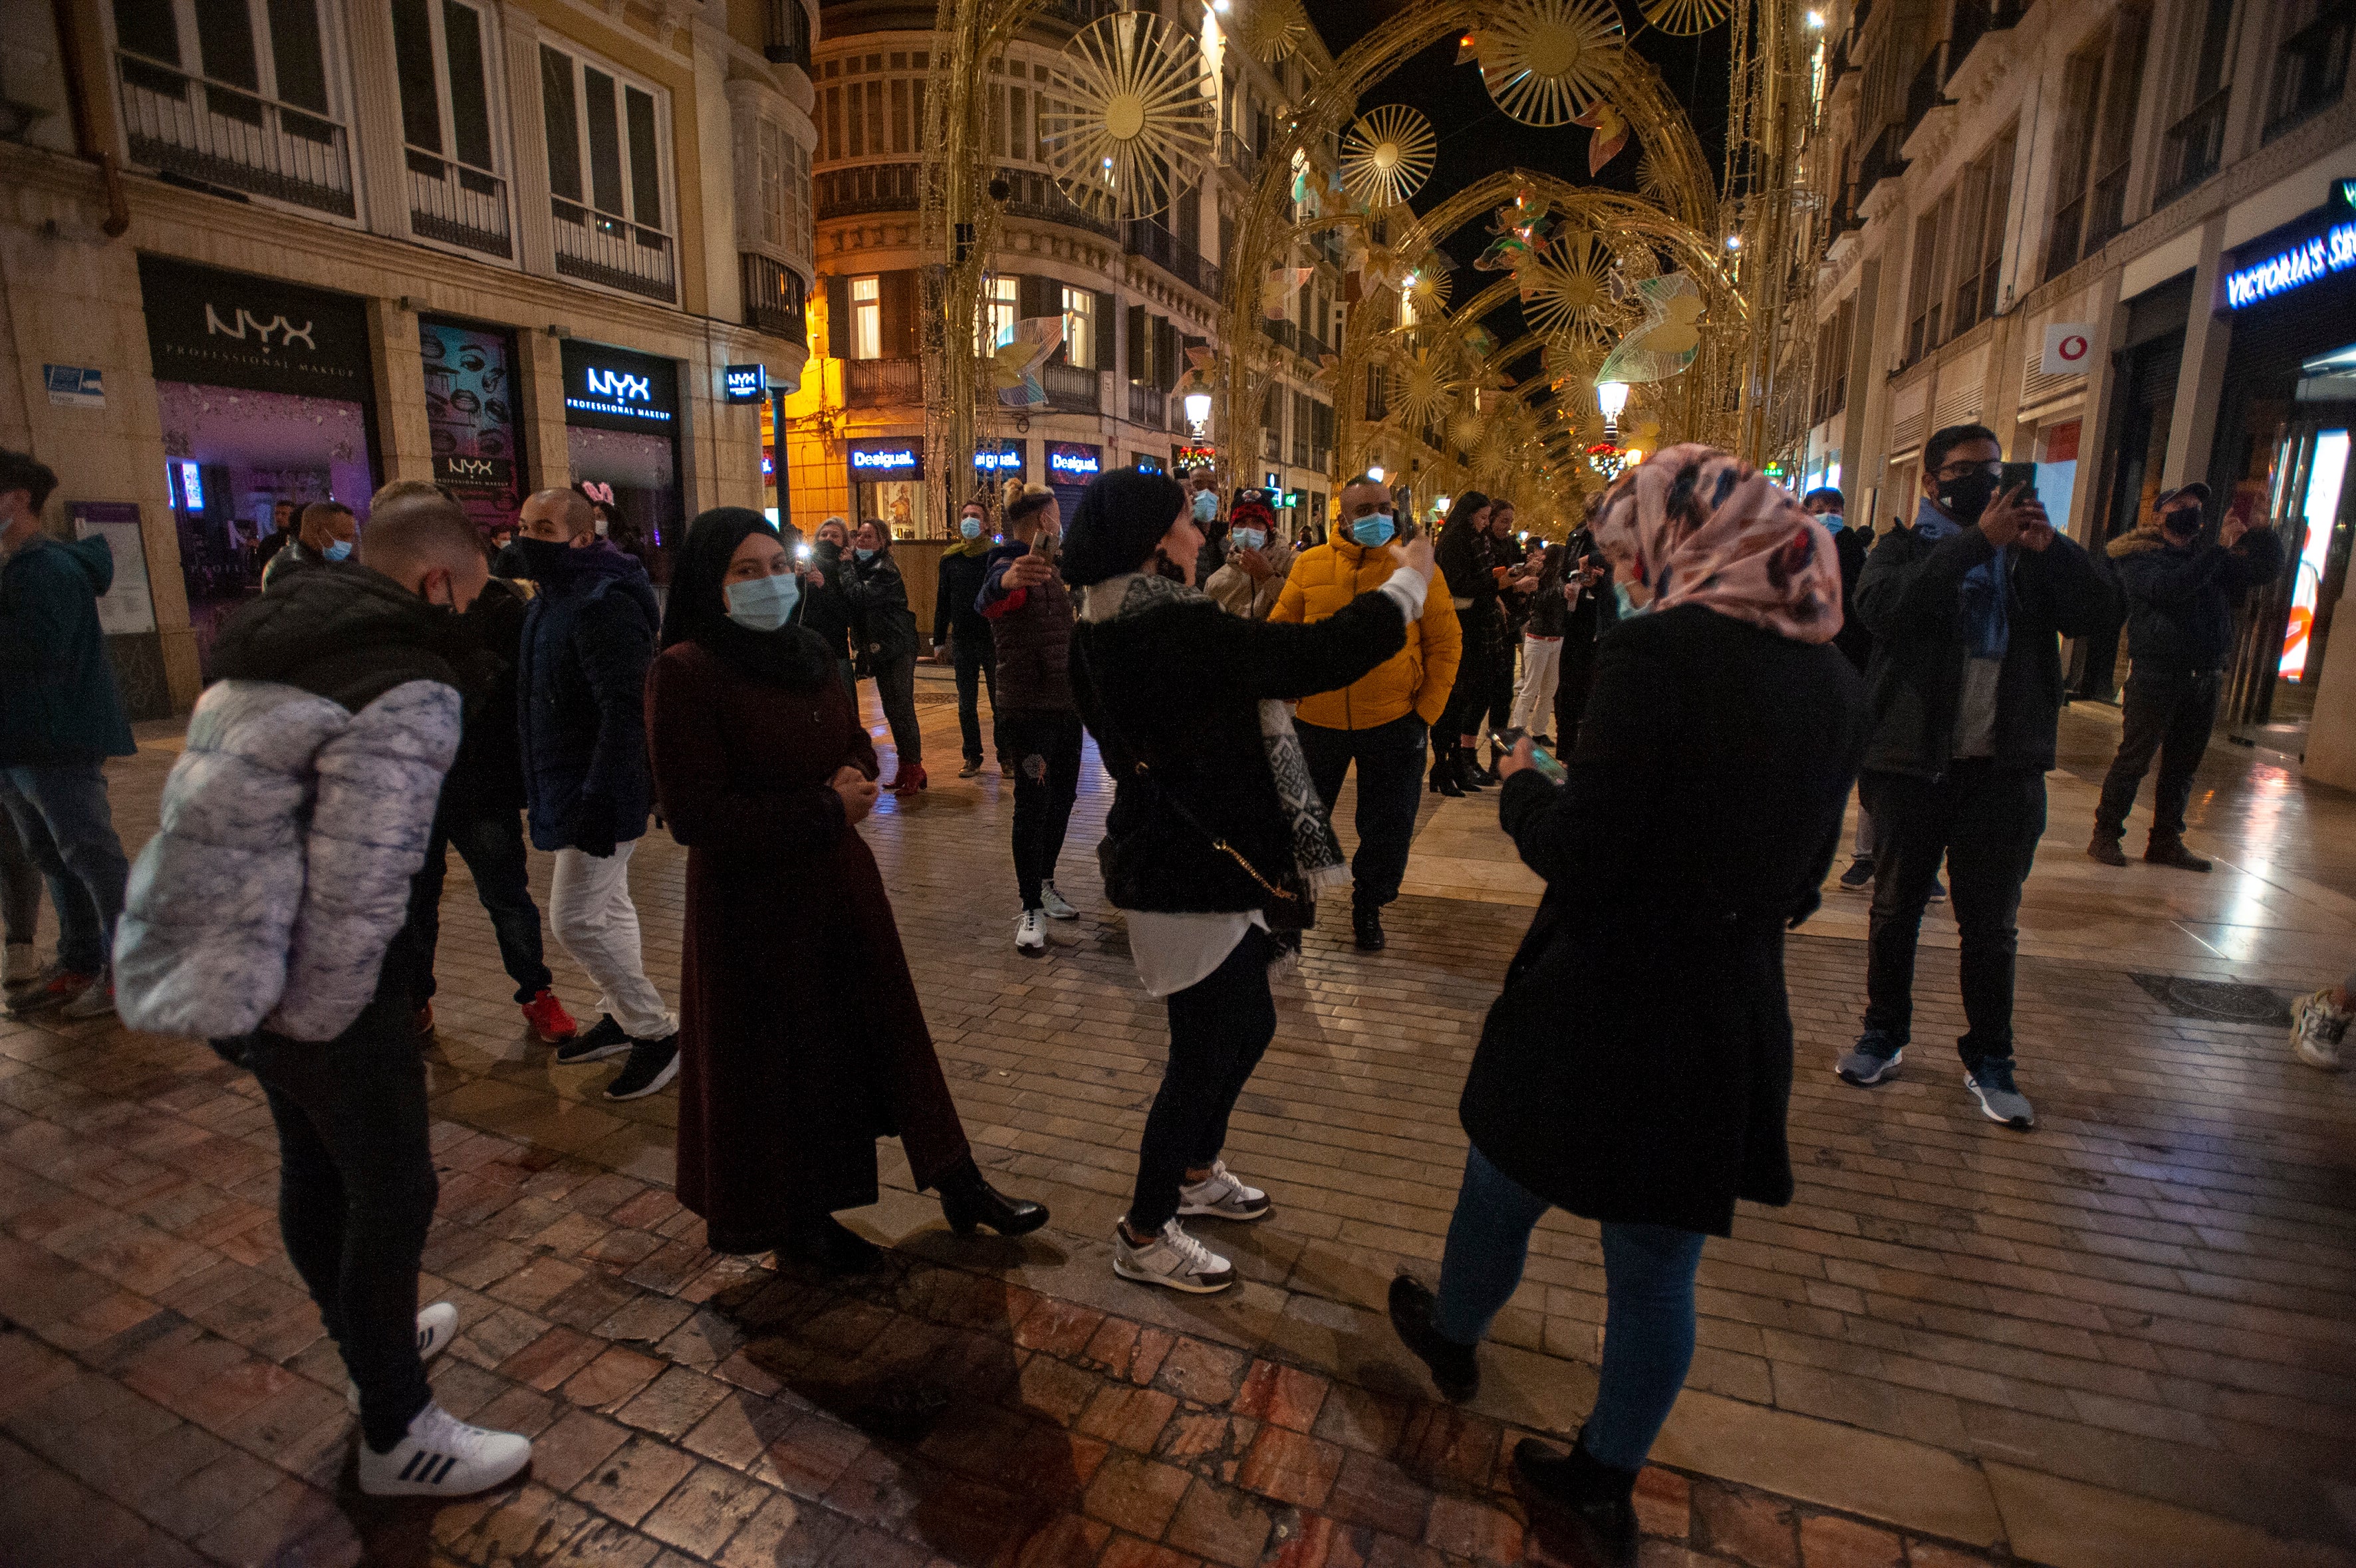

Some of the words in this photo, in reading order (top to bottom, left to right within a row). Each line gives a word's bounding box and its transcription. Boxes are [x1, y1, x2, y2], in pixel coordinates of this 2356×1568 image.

[2226, 236, 2329, 309] VICTORIA'S
[2329, 223, 2356, 272] SE
[205, 303, 316, 350] NYX
[167, 344, 289, 369] PROFESSIONAL
[299, 364, 354, 378] MAKEUP
[587, 367, 650, 400] NYX
[728, 372, 755, 385] NYX
[567, 398, 634, 416] PROFESSIONAL
[637, 408, 670, 420] MAKEUP
[448, 457, 492, 475] NYX
[853, 451, 915, 468] Desigual.
[1052, 454, 1099, 473] Desigual.
